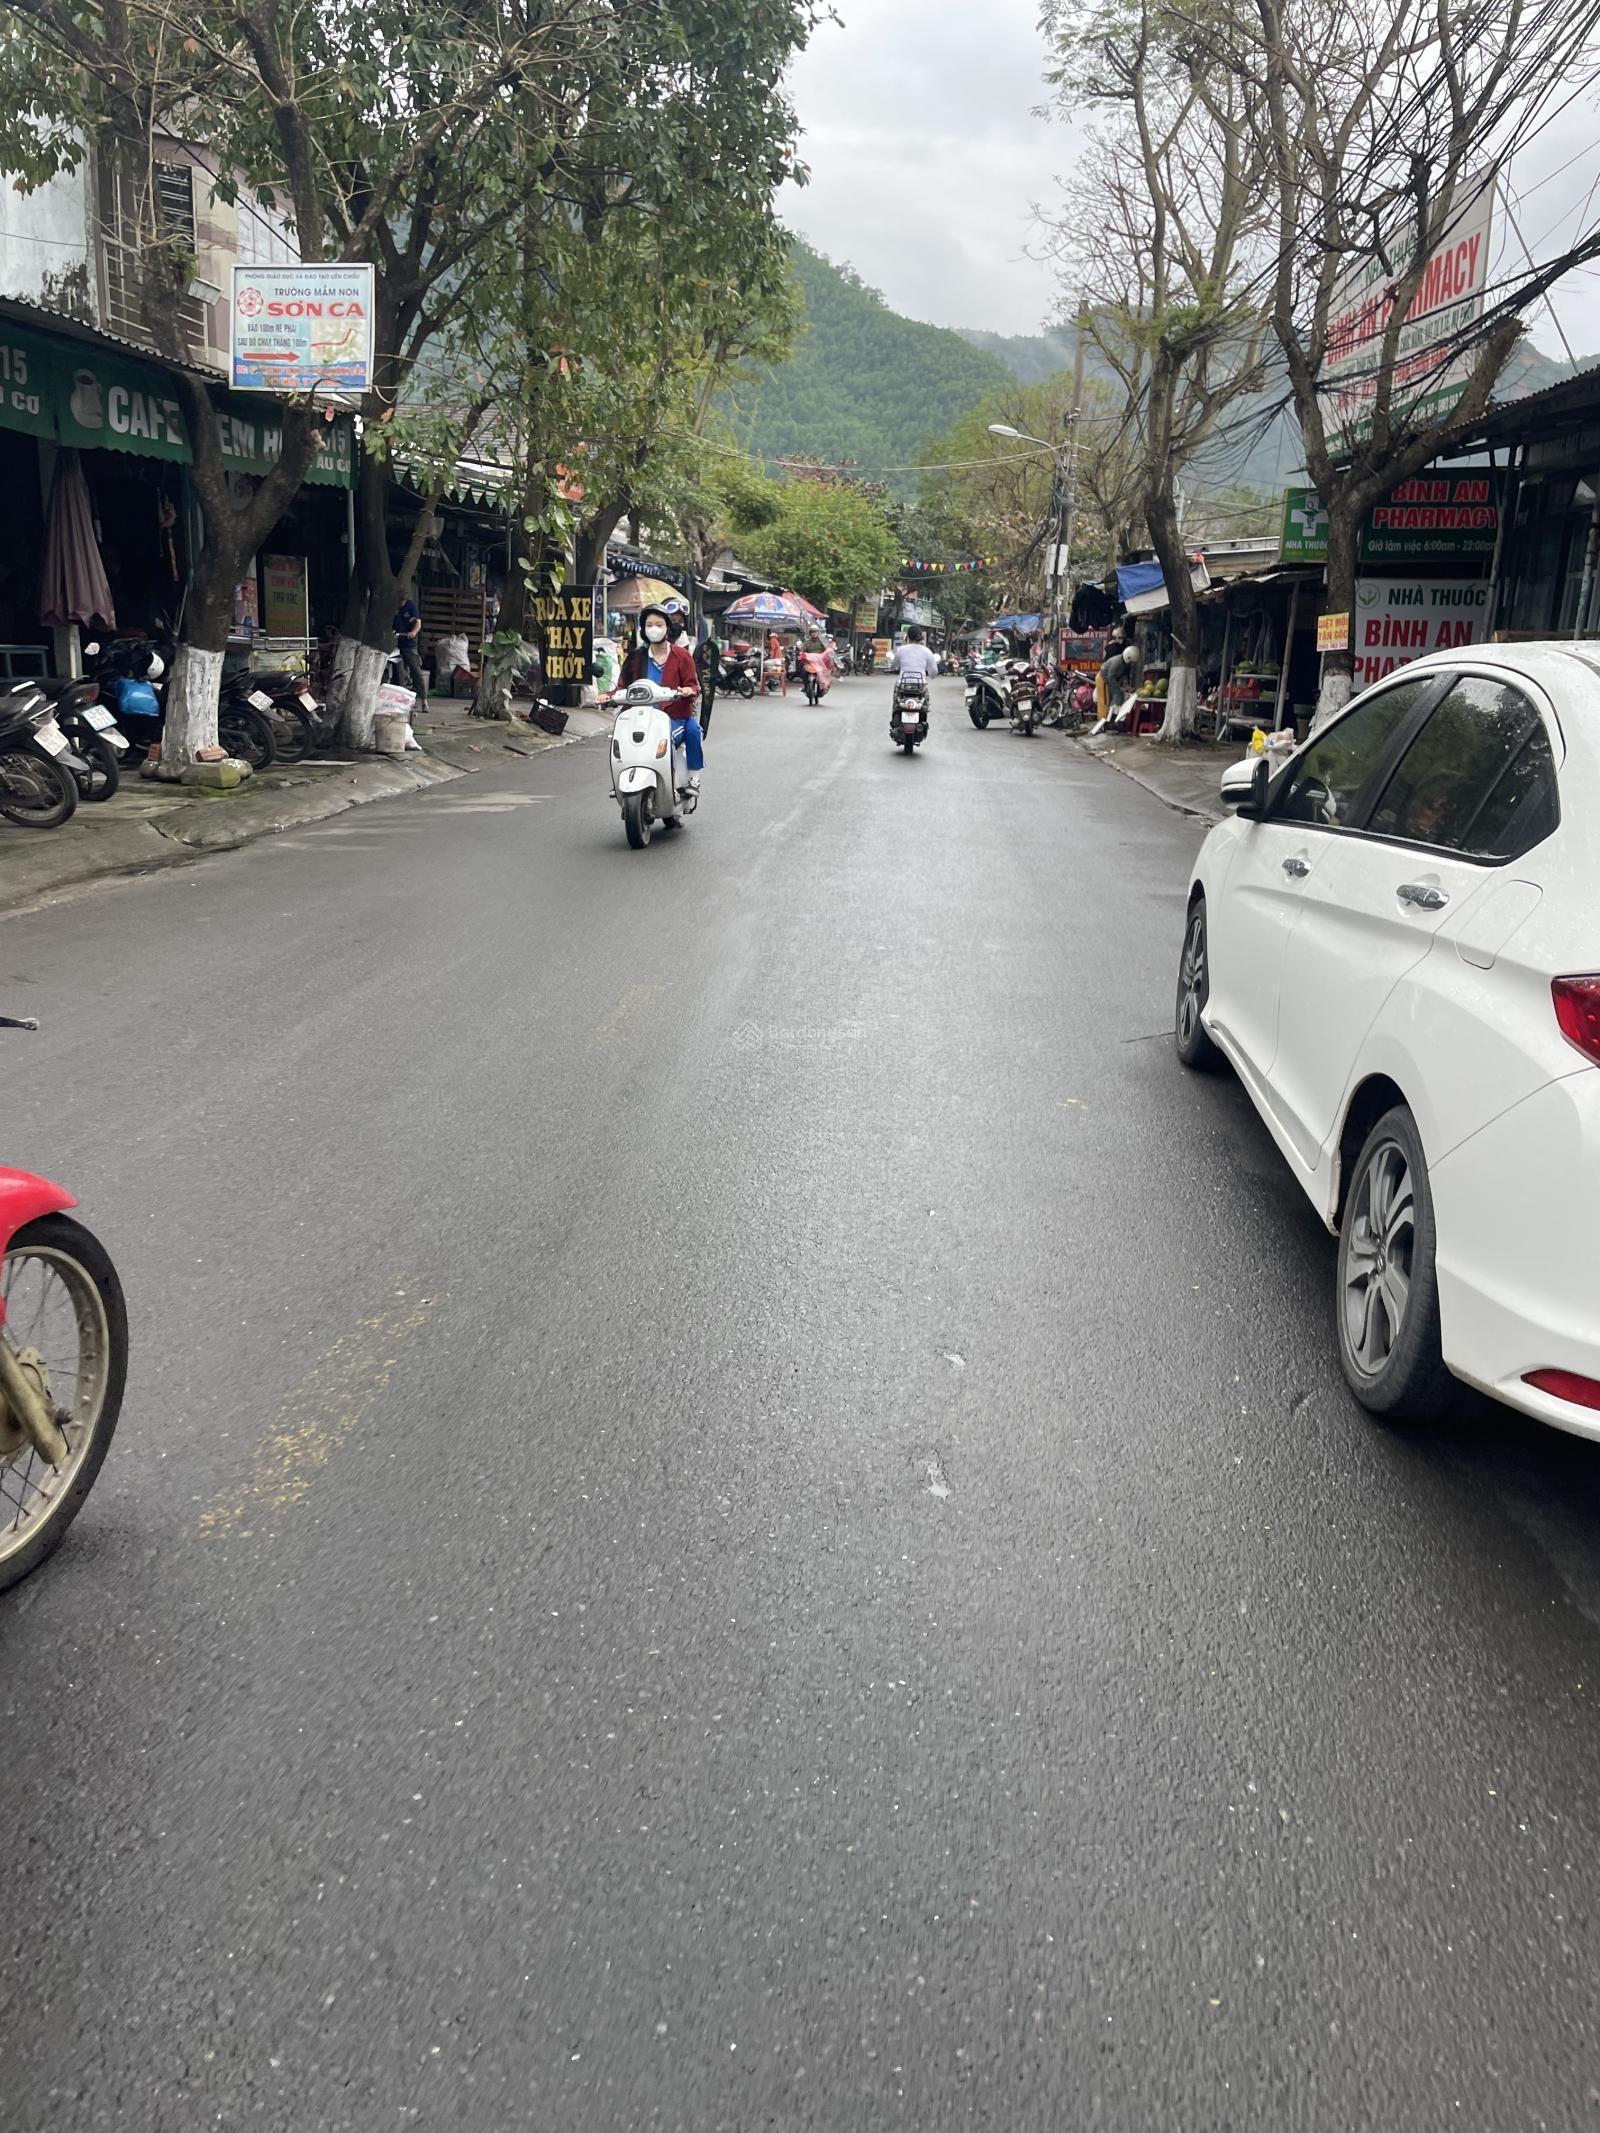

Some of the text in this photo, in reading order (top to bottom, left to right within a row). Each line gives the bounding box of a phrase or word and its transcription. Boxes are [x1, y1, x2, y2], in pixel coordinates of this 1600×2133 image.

[274, 286, 312, 296] TRƯỜNG
[339, 288, 359, 296] NON
[1382, 232, 1481, 334] PRMACY
[267, 300, 364, 317] SƠN CA
[108, 386, 183, 445] CAFE
[1391, 476, 1490, 502] BÌNH AN
[1372, 506, 1498, 529] PHARMACY
[1385, 540, 1401, 551] làm
[1404, 540, 1420, 554] việc
[1462, 541, 1495, 553] 22:00p
[1388, 584, 1487, 606] NHÀ THUỐC
[570, 597, 592, 622] XE
[1364, 613, 1474, 648] BÌNH AN
